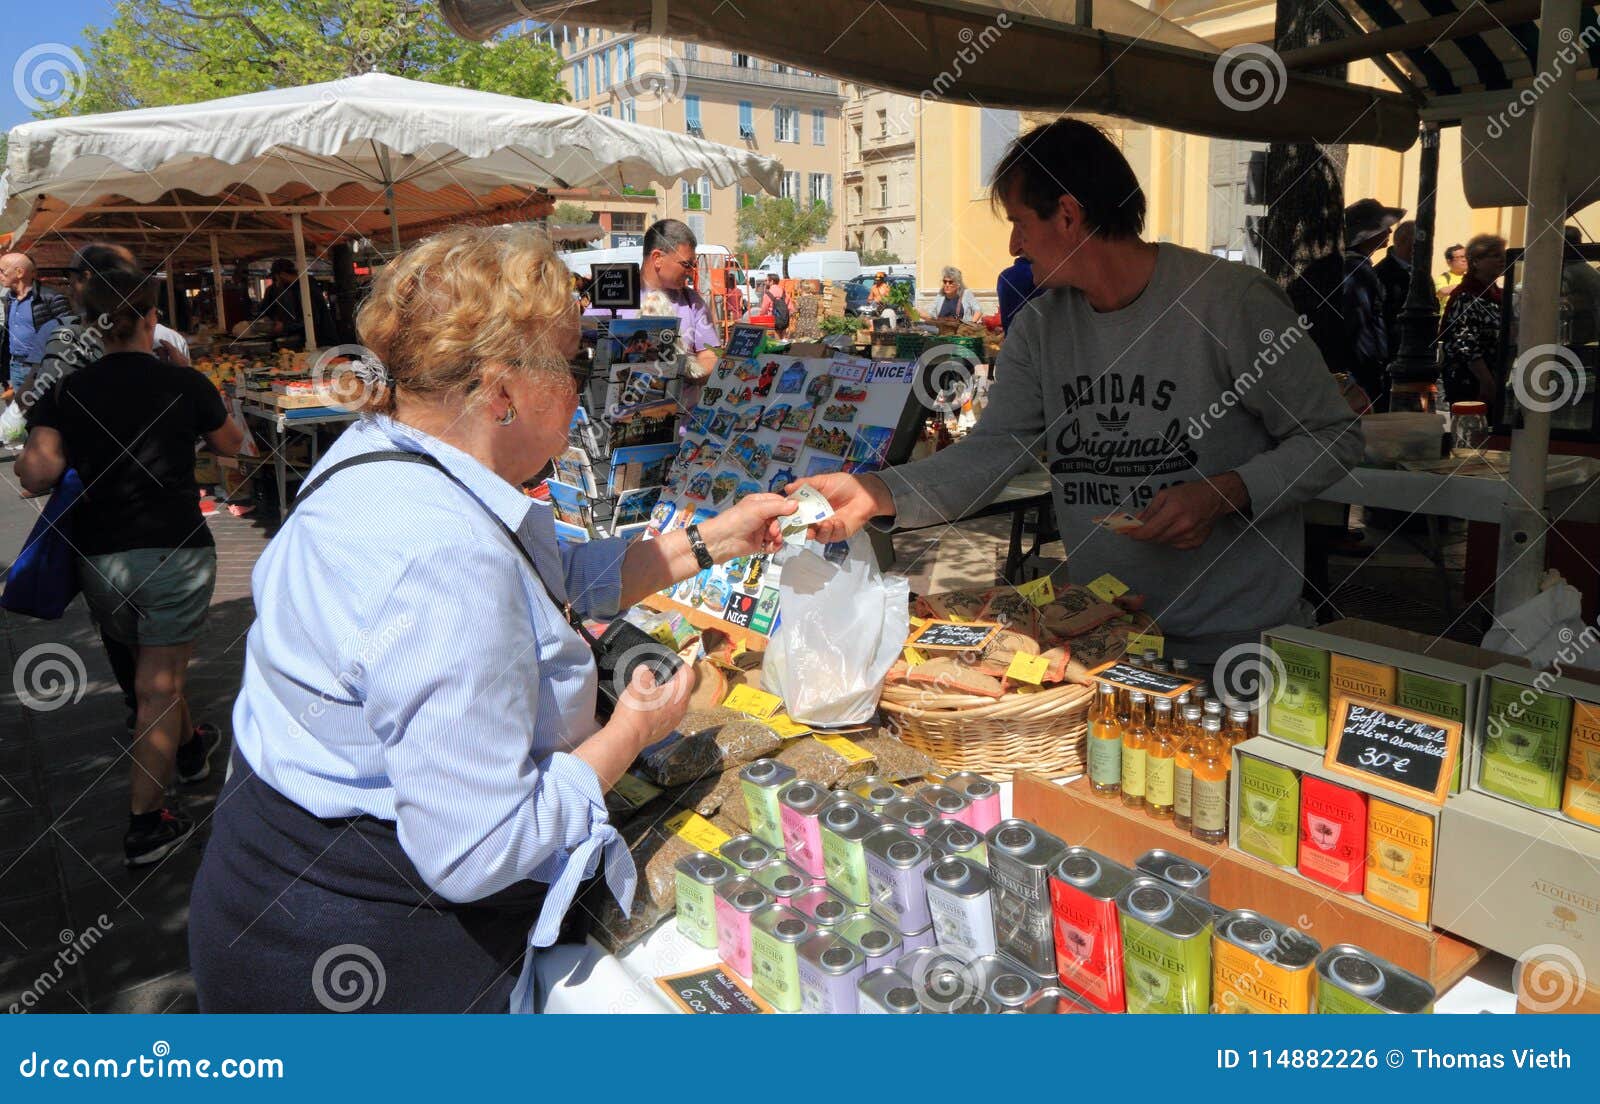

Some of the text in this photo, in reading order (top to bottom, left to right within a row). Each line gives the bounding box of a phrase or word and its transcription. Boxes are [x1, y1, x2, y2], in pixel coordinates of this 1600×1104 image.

[875, 366, 907, 378] NICE
[1062, 372, 1177, 415] ADIDAS
[1055, 417, 1192, 473] Originals
[1063, 479, 1188, 509] SINCE 19
[732, 595, 742, 608] I
[726, 609, 748, 627] NICE
[1357, 747, 1410, 774] 30 €
[1374, 820, 1429, 848] L'OLIVIER
